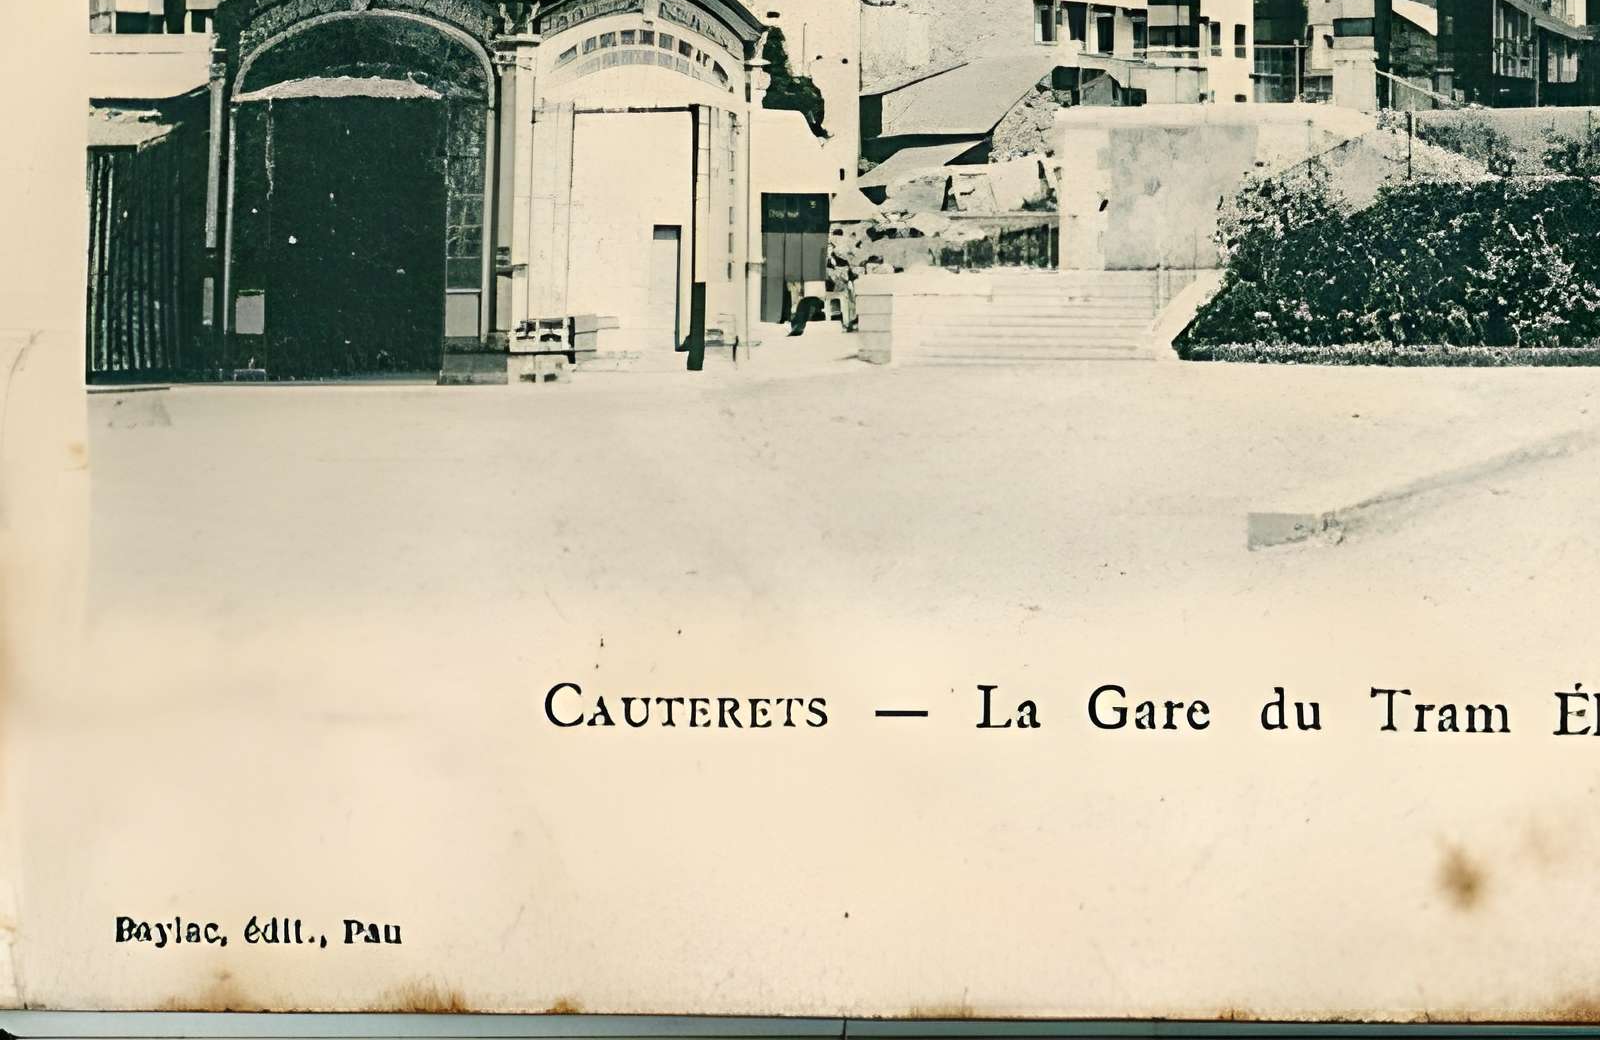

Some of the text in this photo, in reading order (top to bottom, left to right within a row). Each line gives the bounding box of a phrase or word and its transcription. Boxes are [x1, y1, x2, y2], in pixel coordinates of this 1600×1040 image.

[543, 681, 829, 730] CAUTERETS
[974, 683, 1042, 730] La
[1086, 683, 1212, 732] Gare
[1259, 685, 1323, 732] du
[1369, 685, 1512, 735] Tram
[113, 914, 404, 950] Baylac, édit., Pau
